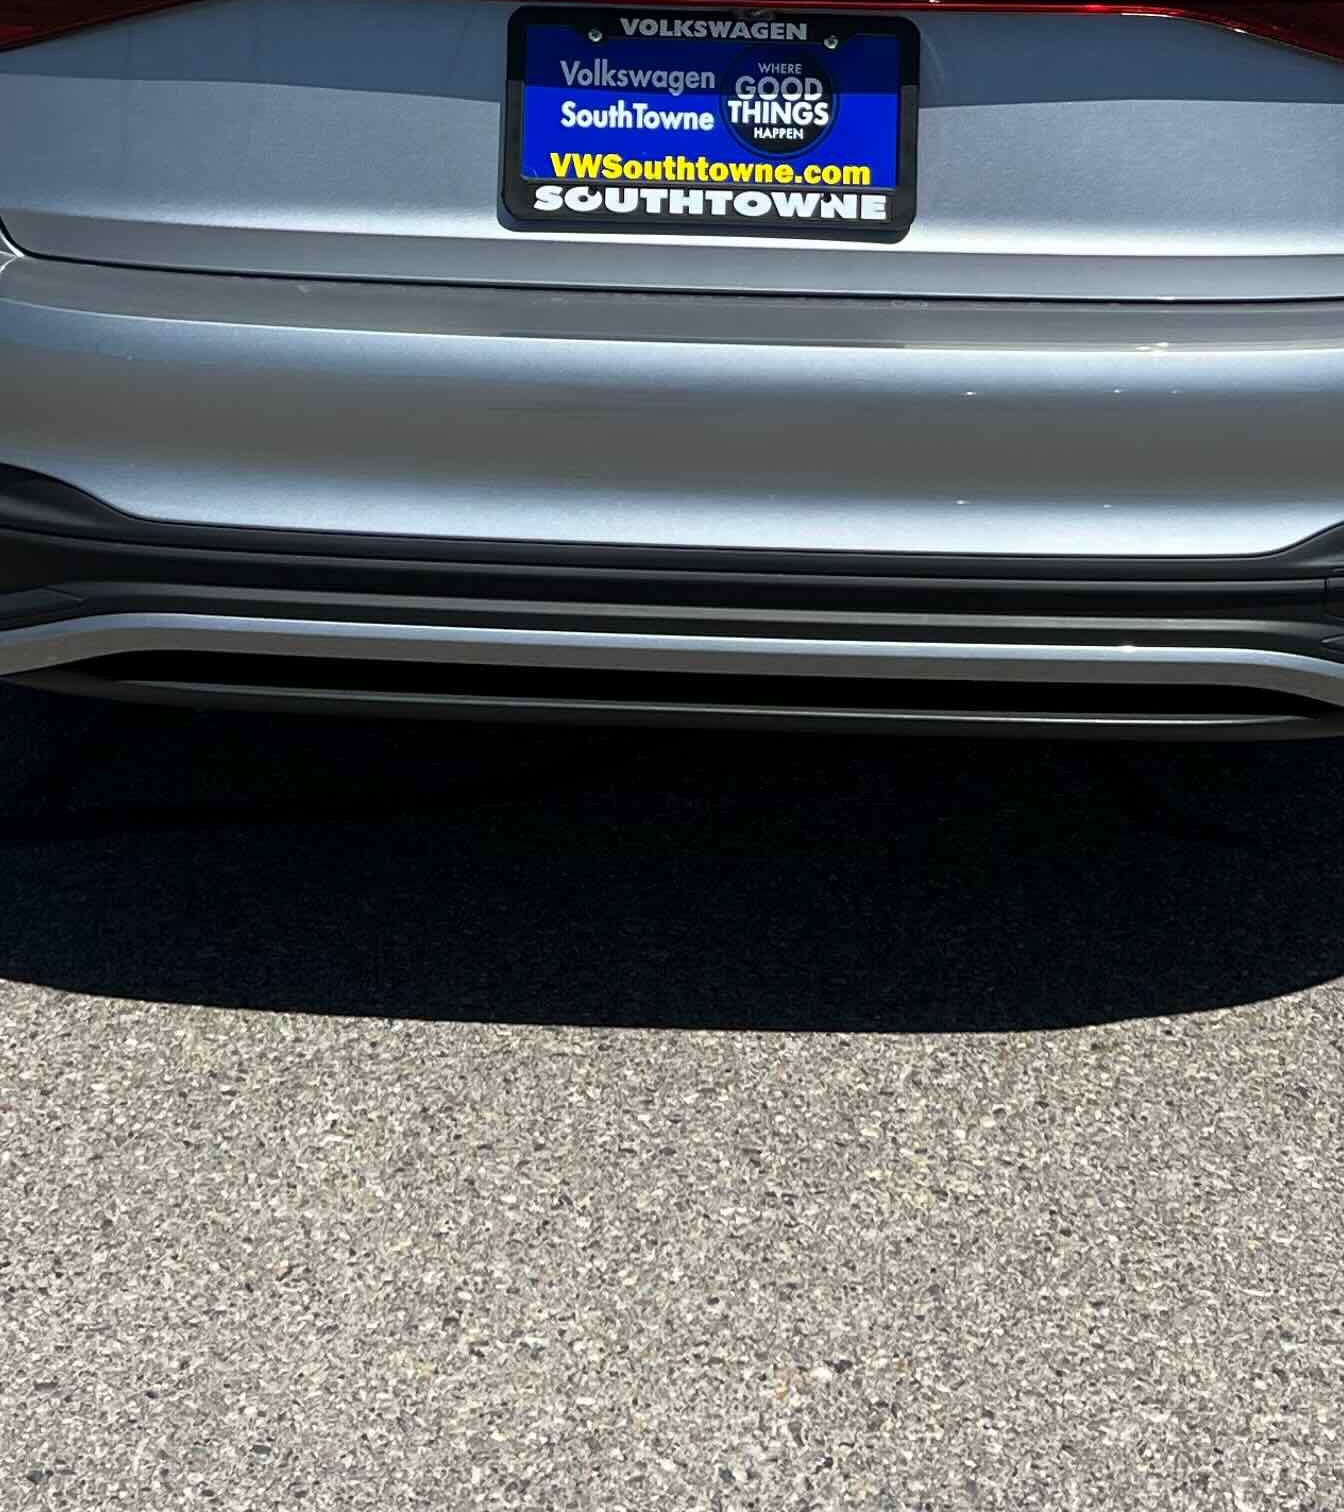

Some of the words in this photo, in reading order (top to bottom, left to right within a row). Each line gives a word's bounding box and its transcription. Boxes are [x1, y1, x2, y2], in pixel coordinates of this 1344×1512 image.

[619, 17, 808, 41] VOLKSWAGEN
[560, 59, 716, 96] Volkswagen
[757, 62, 803, 75] WHERE
[735, 75, 824, 102] GOOD
[727, 100, 830, 127] THINGS
[754, 127, 804, 140] HAPPEN
[550, 152, 872, 186] VWSouthtowne.com
[533, 185, 888, 222] SOUTHTOWNE
